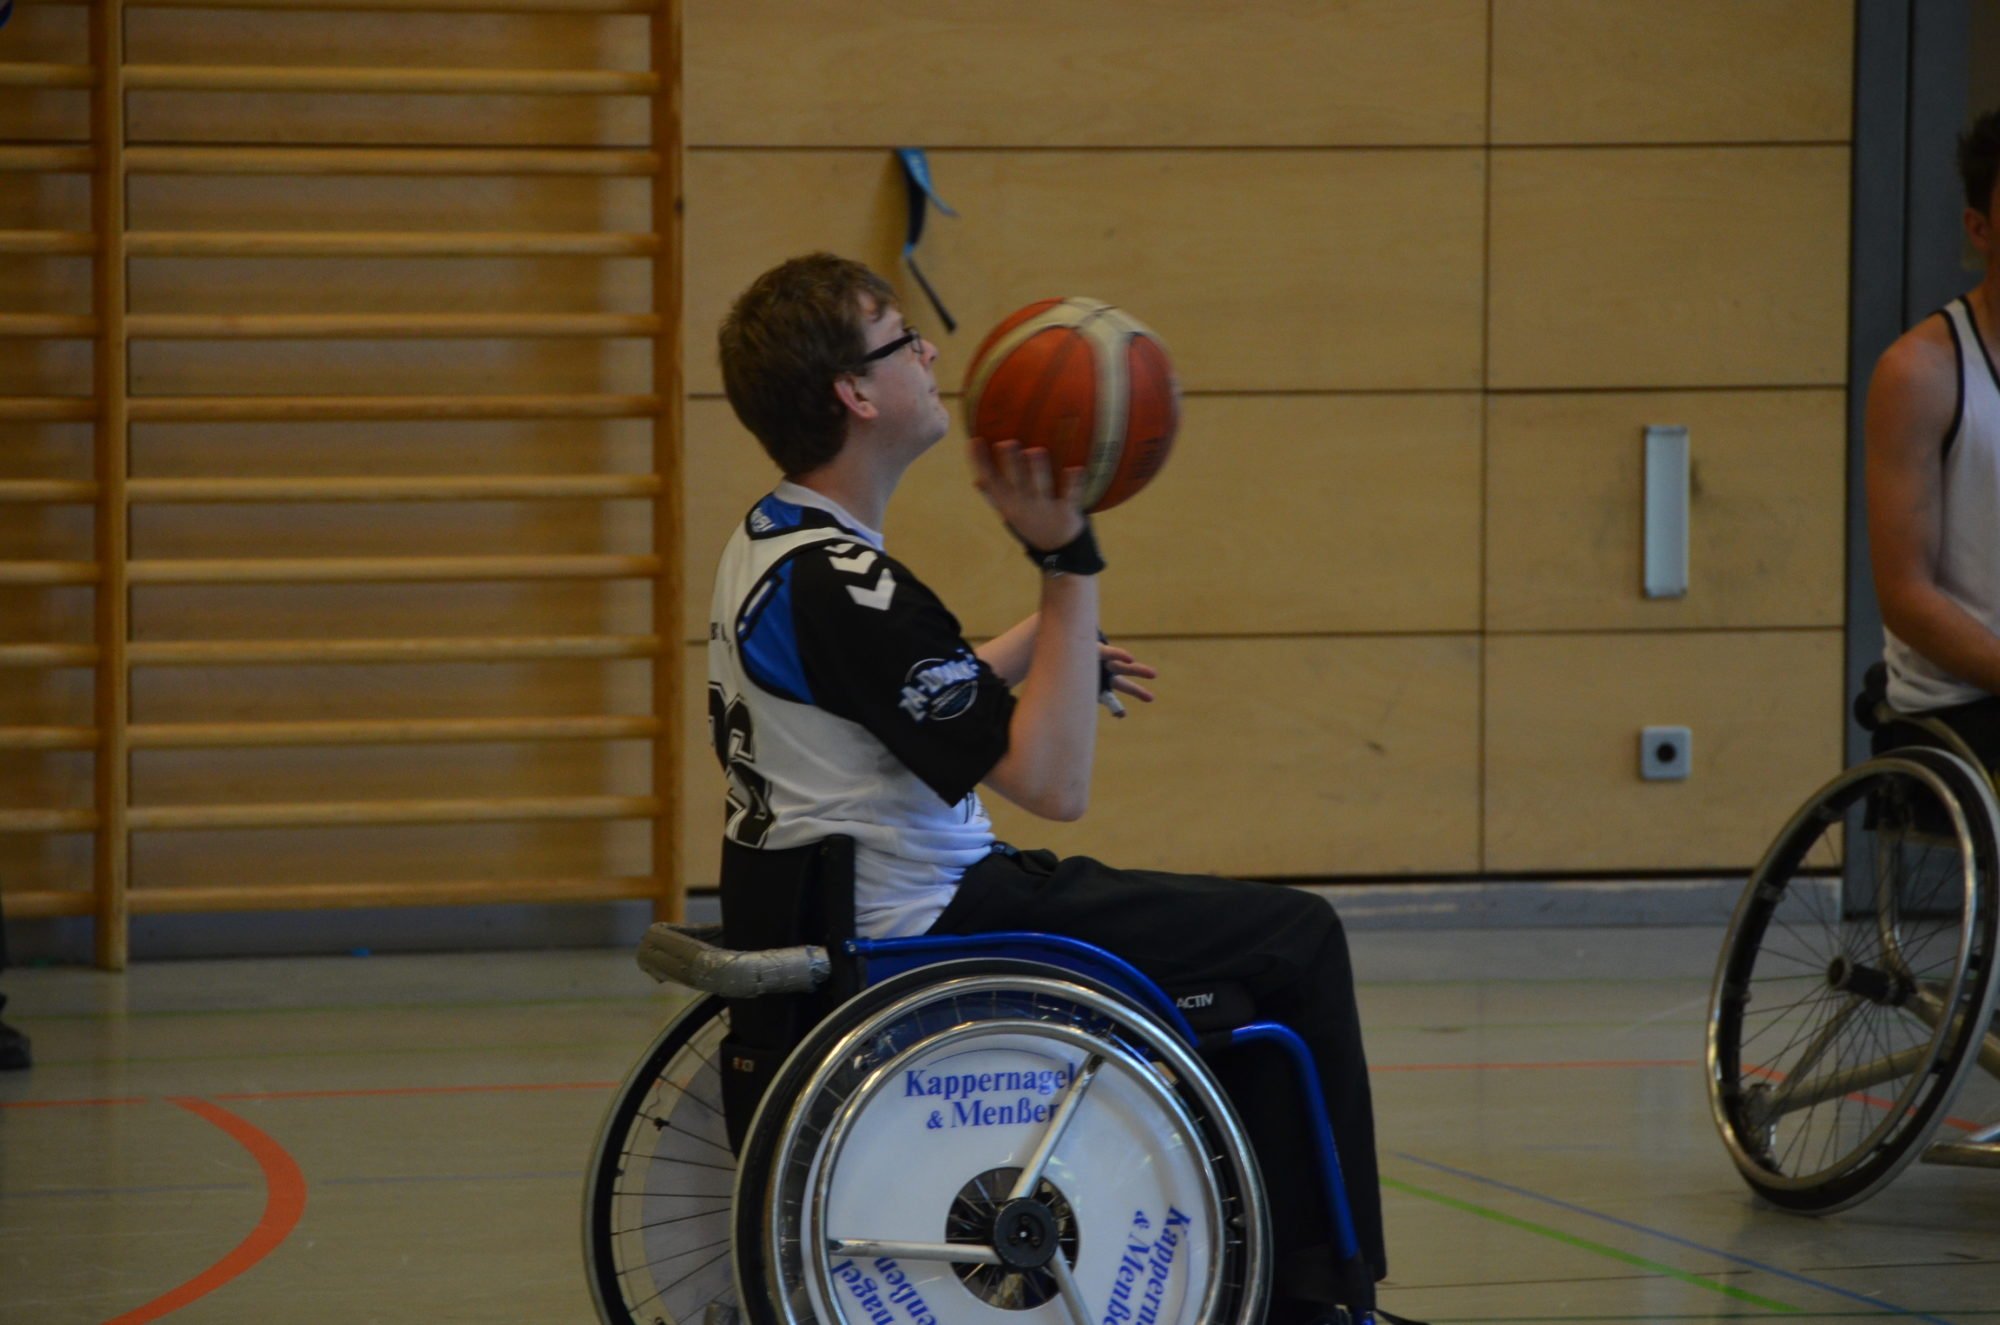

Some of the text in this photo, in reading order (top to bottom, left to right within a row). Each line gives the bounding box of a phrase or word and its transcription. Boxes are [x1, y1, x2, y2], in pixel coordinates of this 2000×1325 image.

[904, 1062, 1076, 1100] Kappernagel
[926, 1110, 943, 1129] &
[1133, 1210, 1150, 1229] &
[1135, 1206, 1191, 1325] Kappern
[831, 1259, 895, 1325] nagel
